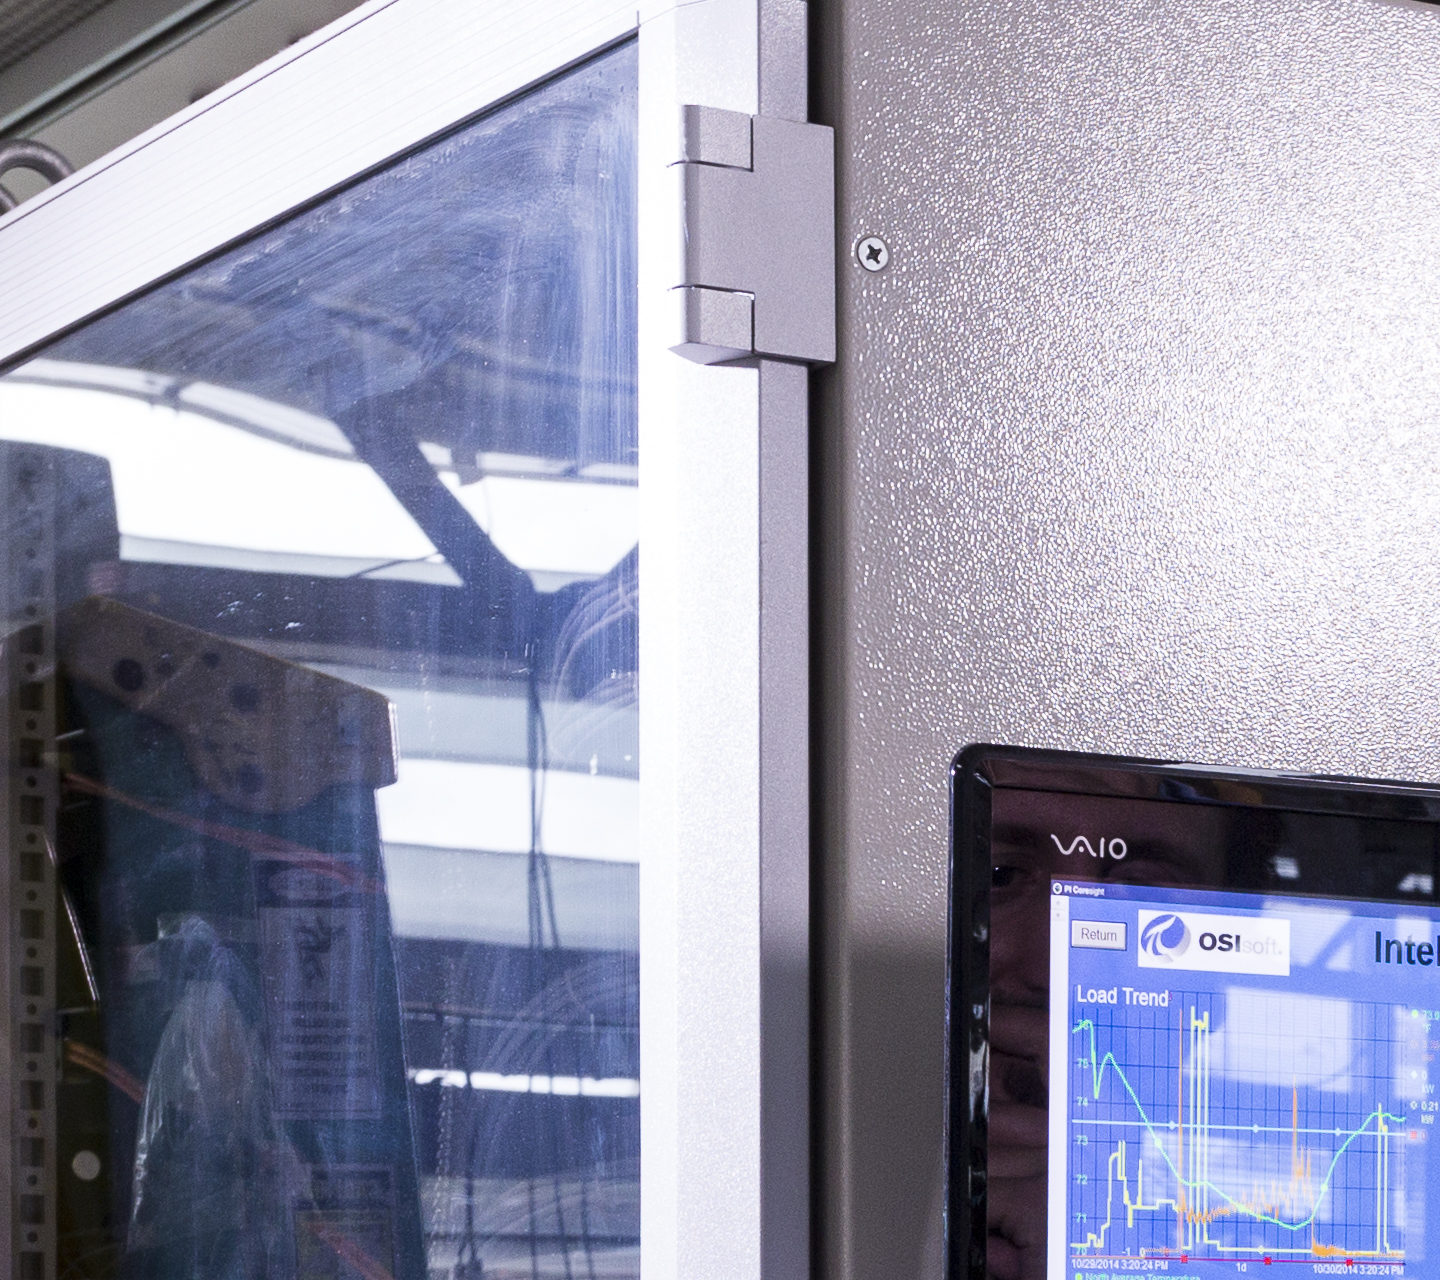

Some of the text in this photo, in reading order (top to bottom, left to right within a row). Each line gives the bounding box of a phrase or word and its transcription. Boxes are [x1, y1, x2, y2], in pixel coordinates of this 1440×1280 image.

[1051, 834, 1128, 860] VAIO
[1073, 886, 1105, 897] Coresight
[1080, 928, 1117, 942] Return
[1077, 984, 1169, 1008] Load Trend
[1236, 1262, 1247, 1272] 1d
